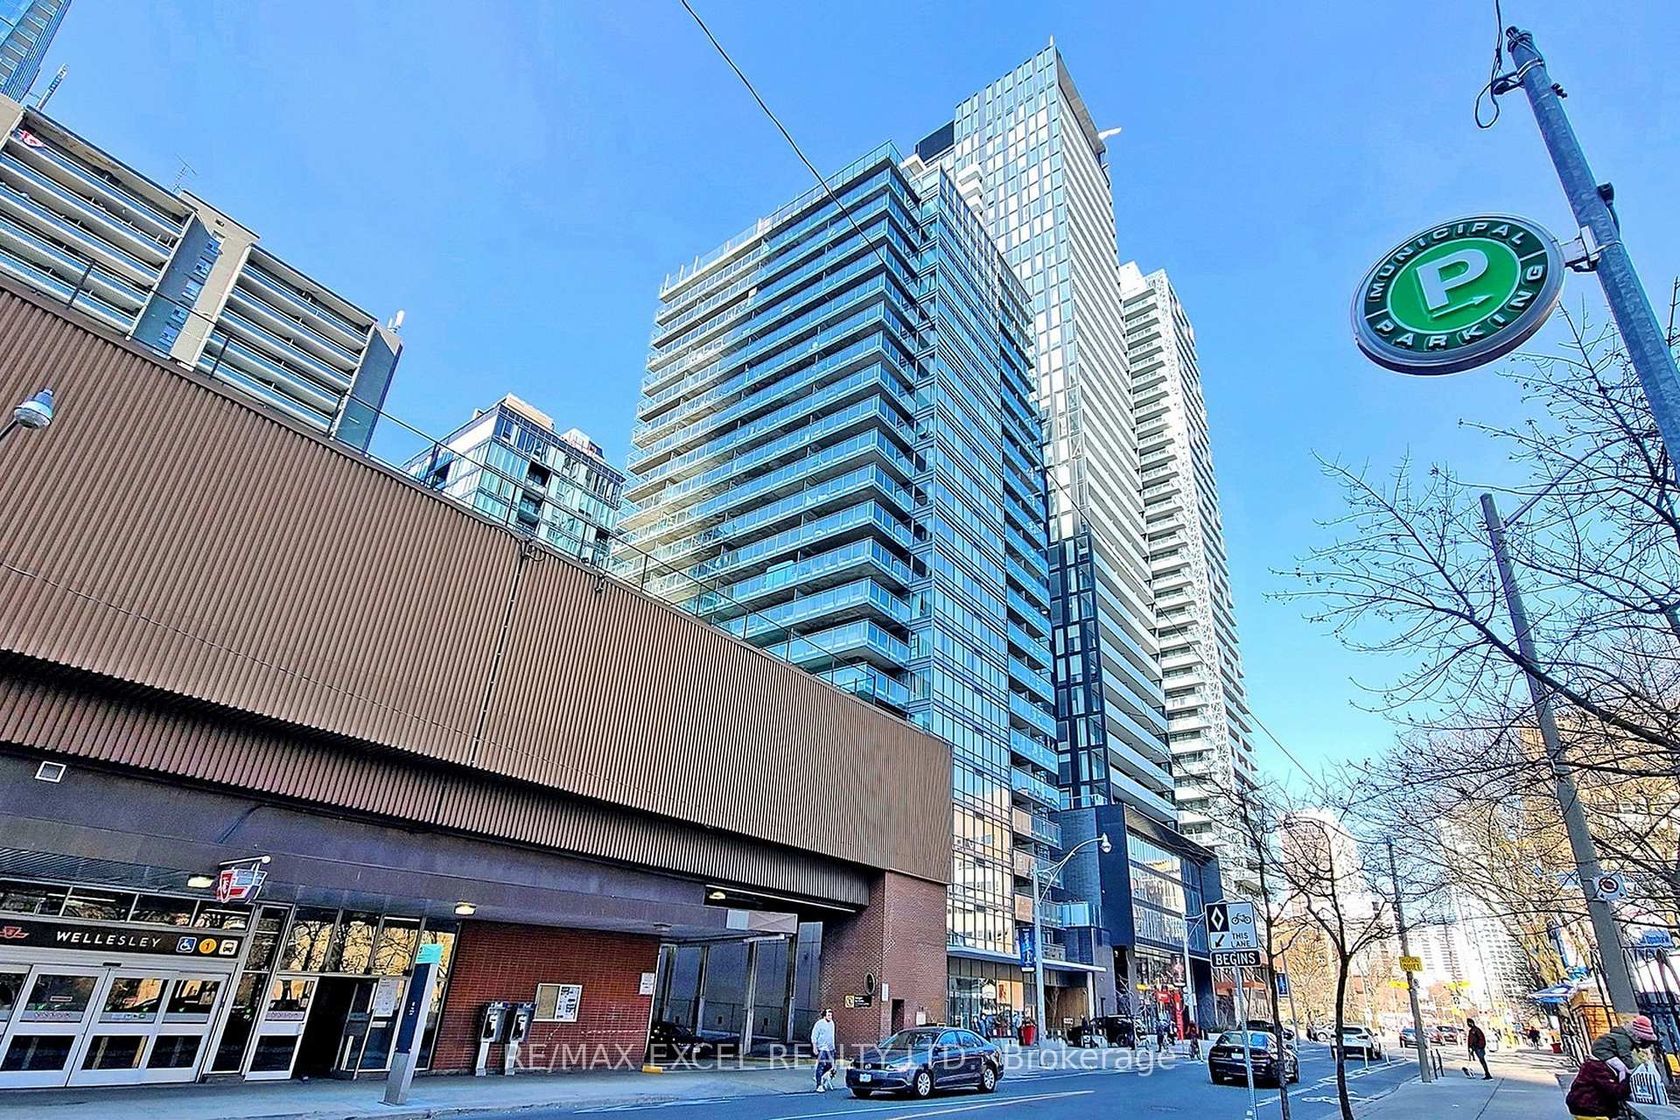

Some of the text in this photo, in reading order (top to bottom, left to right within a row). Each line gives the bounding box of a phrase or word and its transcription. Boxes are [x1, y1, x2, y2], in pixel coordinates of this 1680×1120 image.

[1369, 221, 1527, 302] MUNICIPAL
[1416, 249, 1488, 311] P
[1376, 264, 1544, 349] PARKING
[56, 930, 162, 948] WELLESLEY
[1232, 932, 1249, 940] THIS
[1215, 951, 1257, 966] BEGINS
